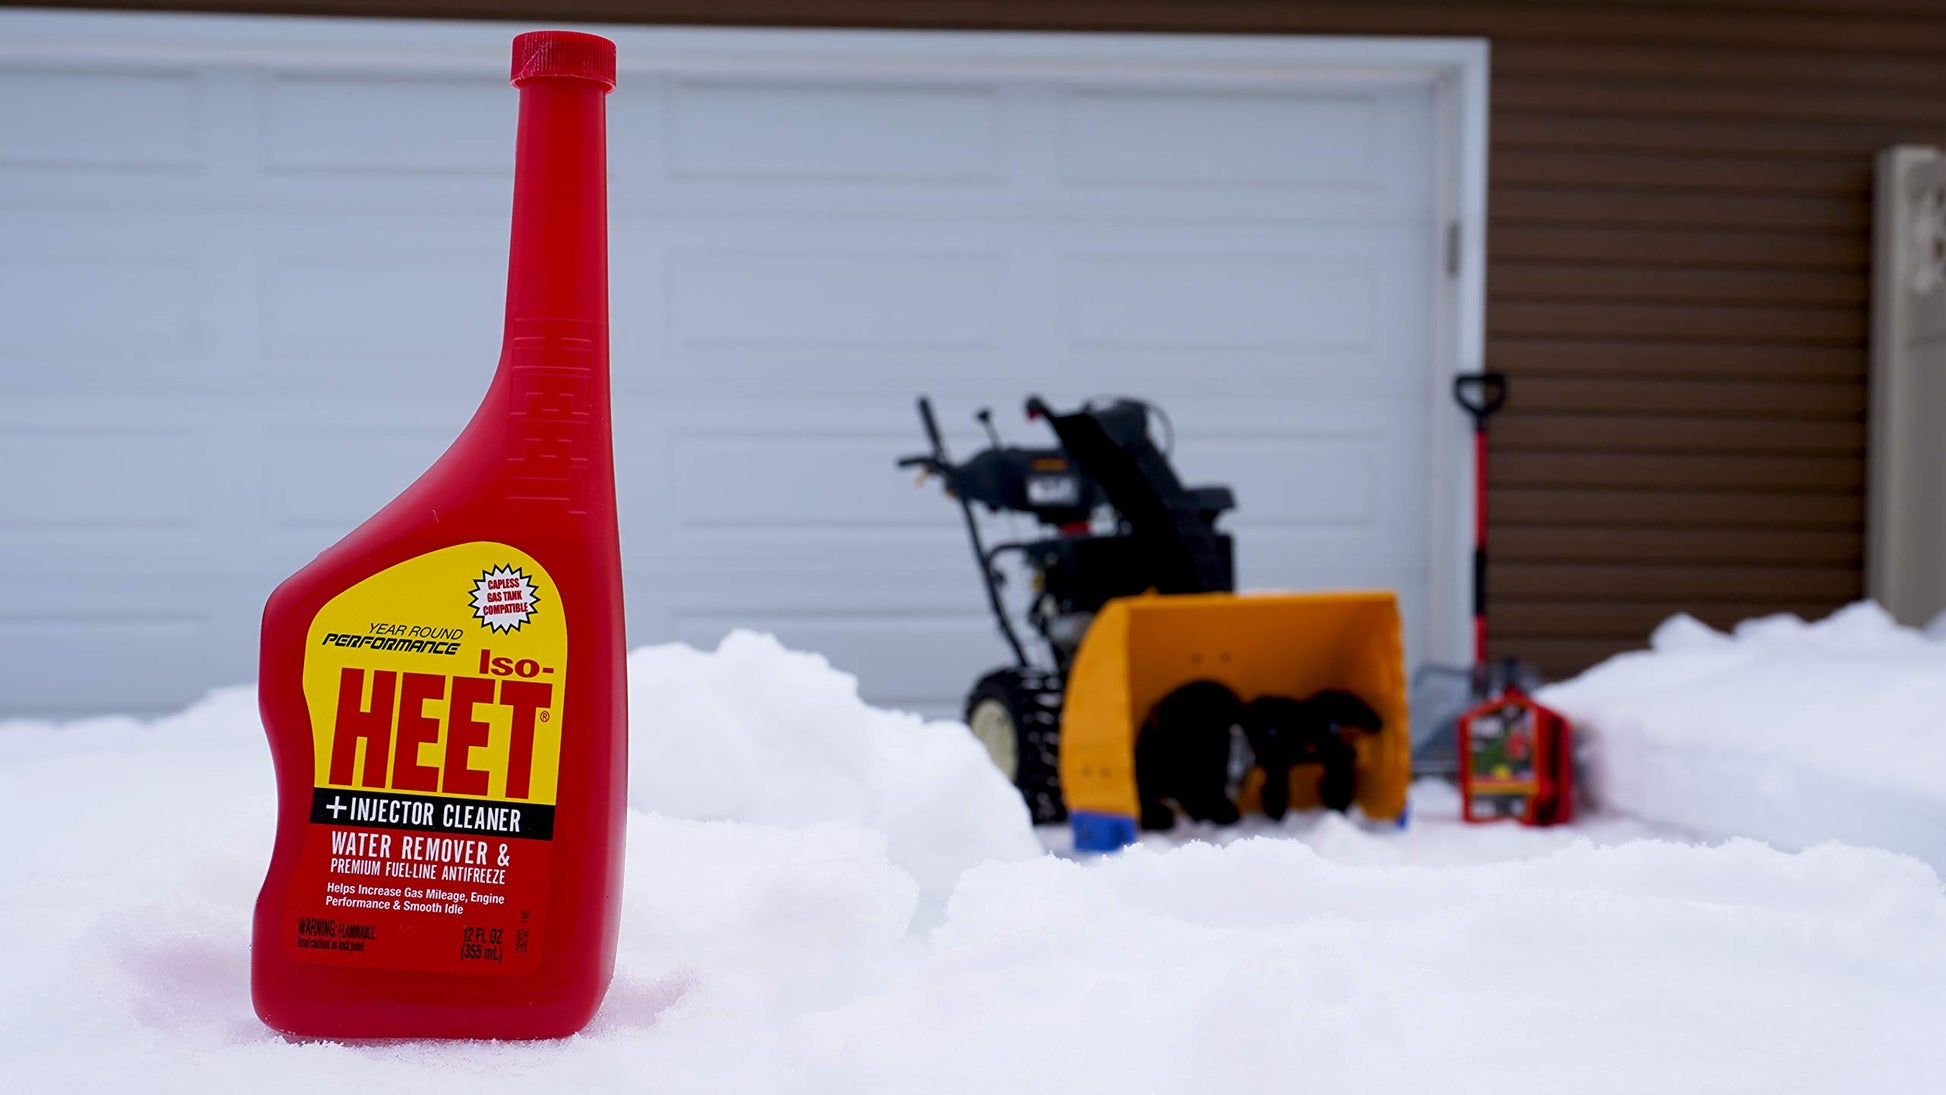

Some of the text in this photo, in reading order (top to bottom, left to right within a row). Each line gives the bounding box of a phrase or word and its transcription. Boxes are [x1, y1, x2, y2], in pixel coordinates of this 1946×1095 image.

[487, 577, 520, 590] CAPLESS
[487, 590, 523, 603] GAS TANK
[483, 602, 528, 616] COMPATIBLE
[369, 622, 464, 640] YEAR ROUND
[322, 633, 461, 655] PERFORMANCE
[479, 649, 554, 678] Iso-
[442, 803, 521, 833] CLEANER
[331, 831, 510, 867] WATER REMOVER &
[330, 858, 506, 885] PREMIUM FUEL-LINE ANTIFREEZE
[327, 882, 505, 905] Helps Increase Gas Mileage, Engine
[325, 896, 464, 915] Performance & Smooth Idle
[463, 927, 503, 945] 12 FL OZ
[460, 943, 503, 964] (355 mL)
